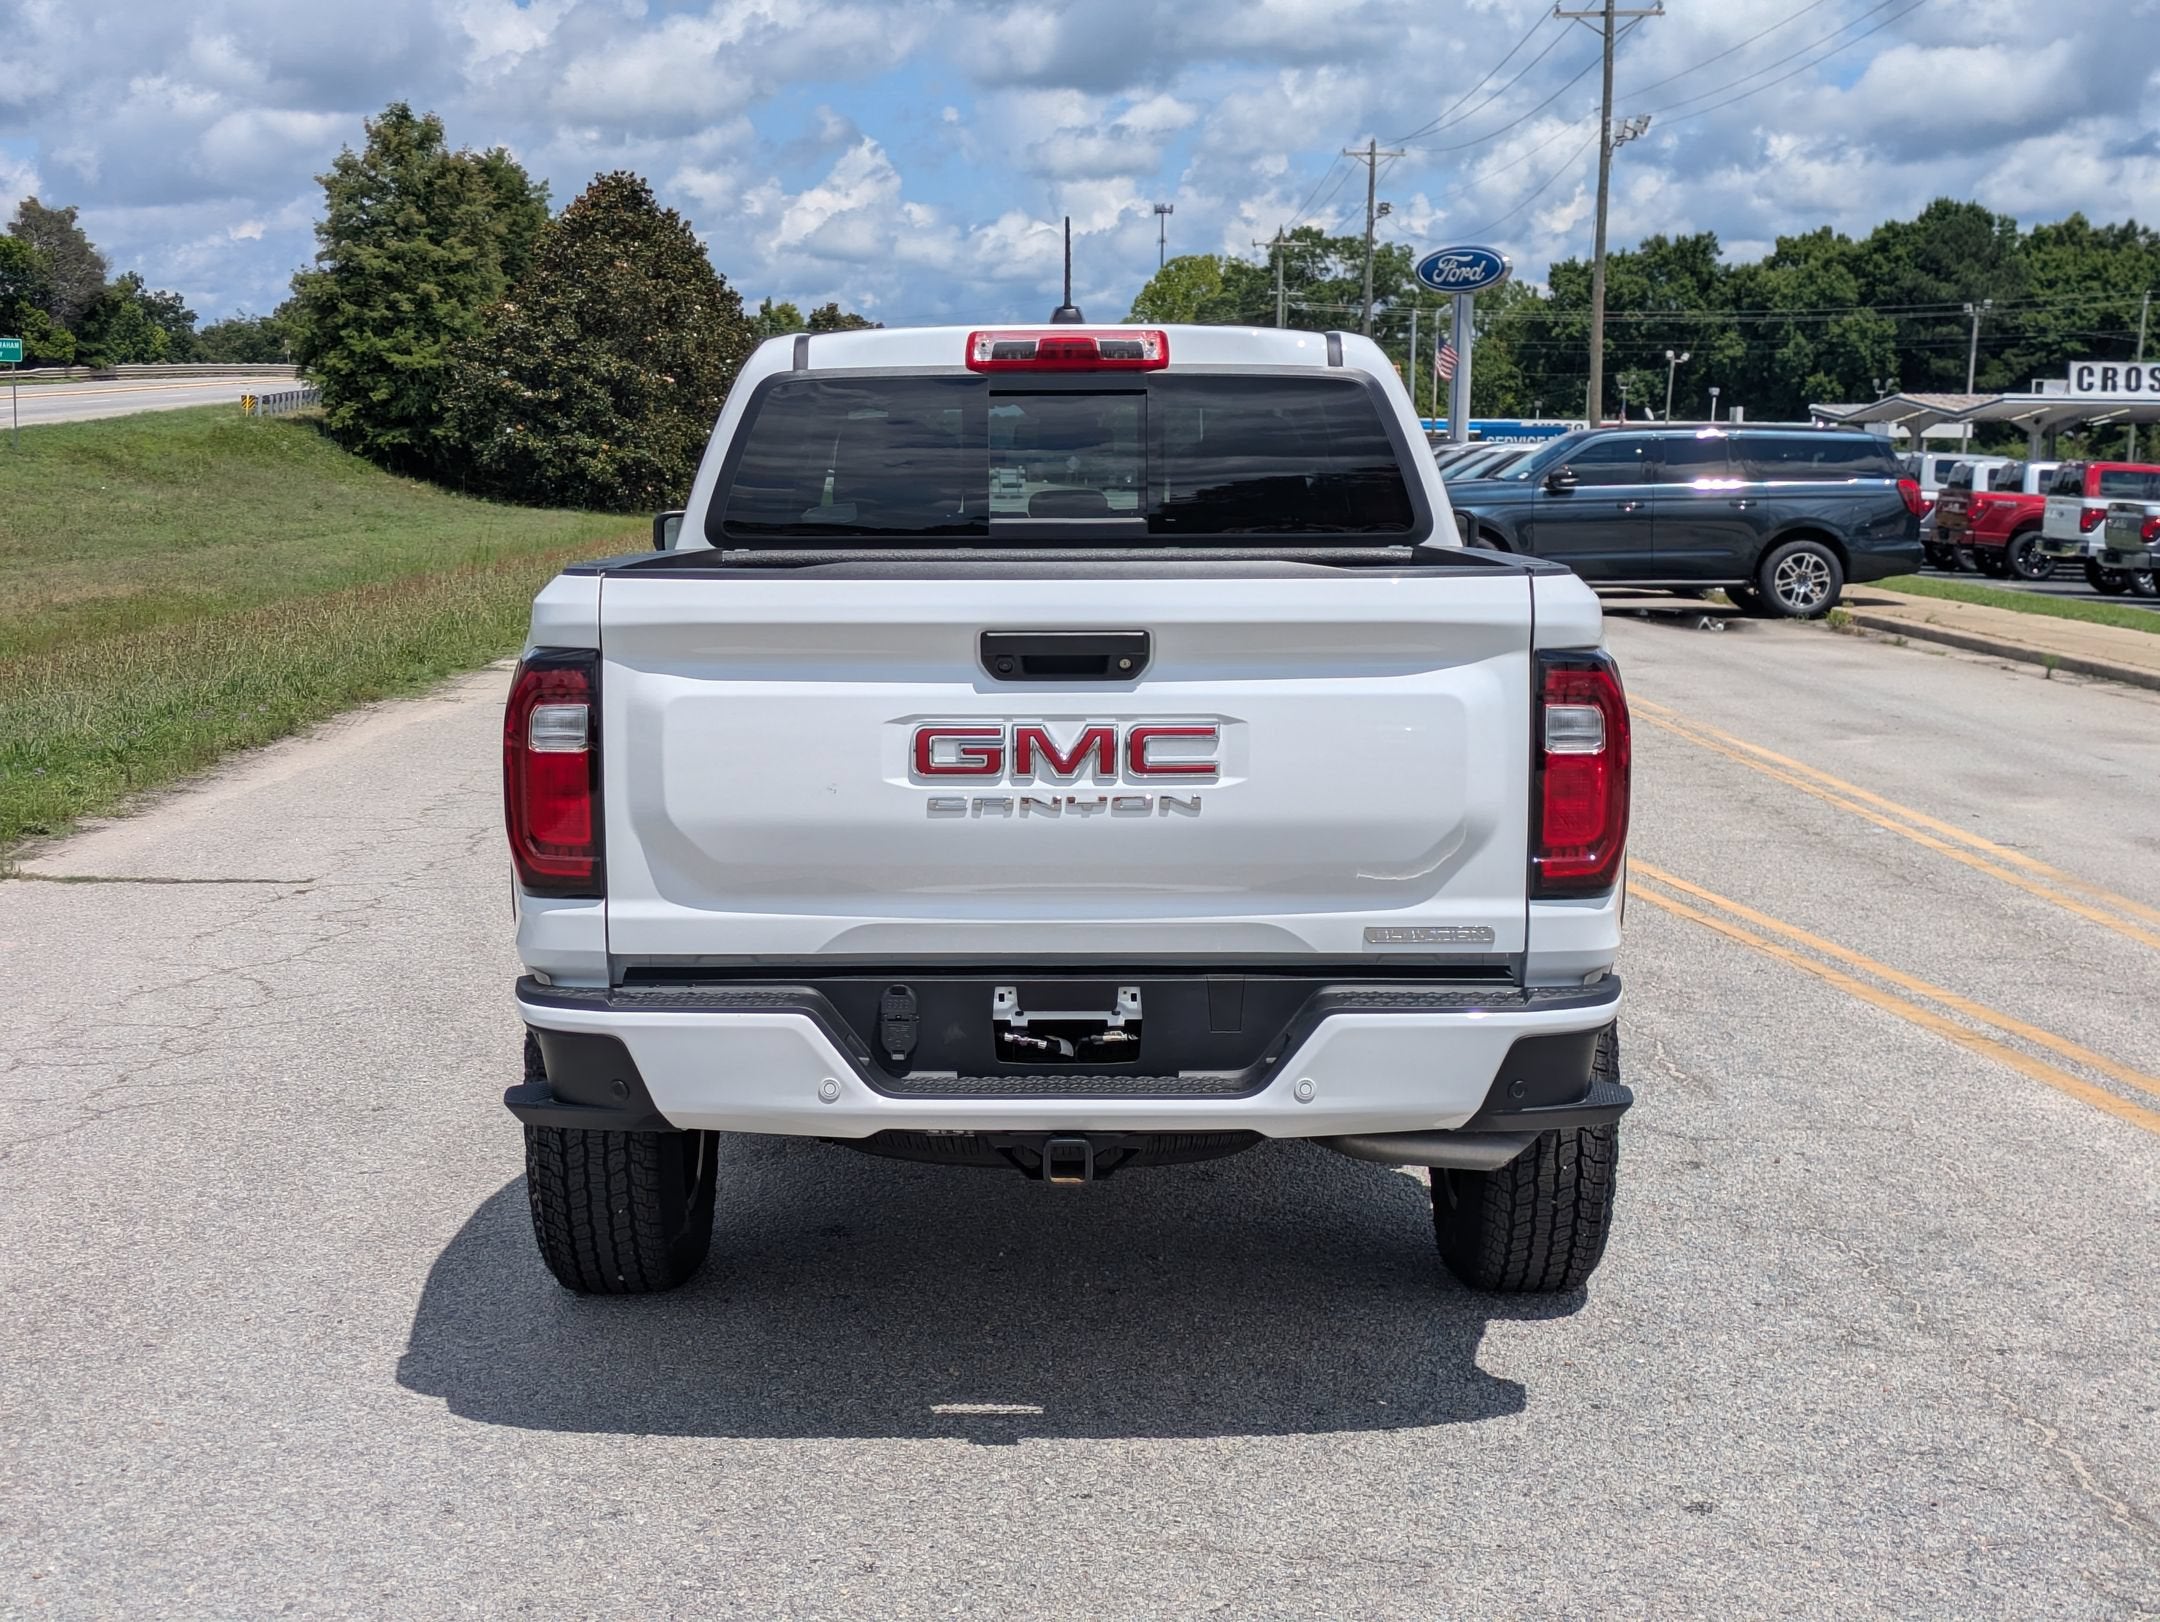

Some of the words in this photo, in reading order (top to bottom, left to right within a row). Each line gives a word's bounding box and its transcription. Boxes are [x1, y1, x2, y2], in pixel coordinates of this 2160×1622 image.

[1432, 255, 1487, 283] Ford
[911, 722, 1221, 779] GMC
[926, 794, 1202, 813] CANYON
